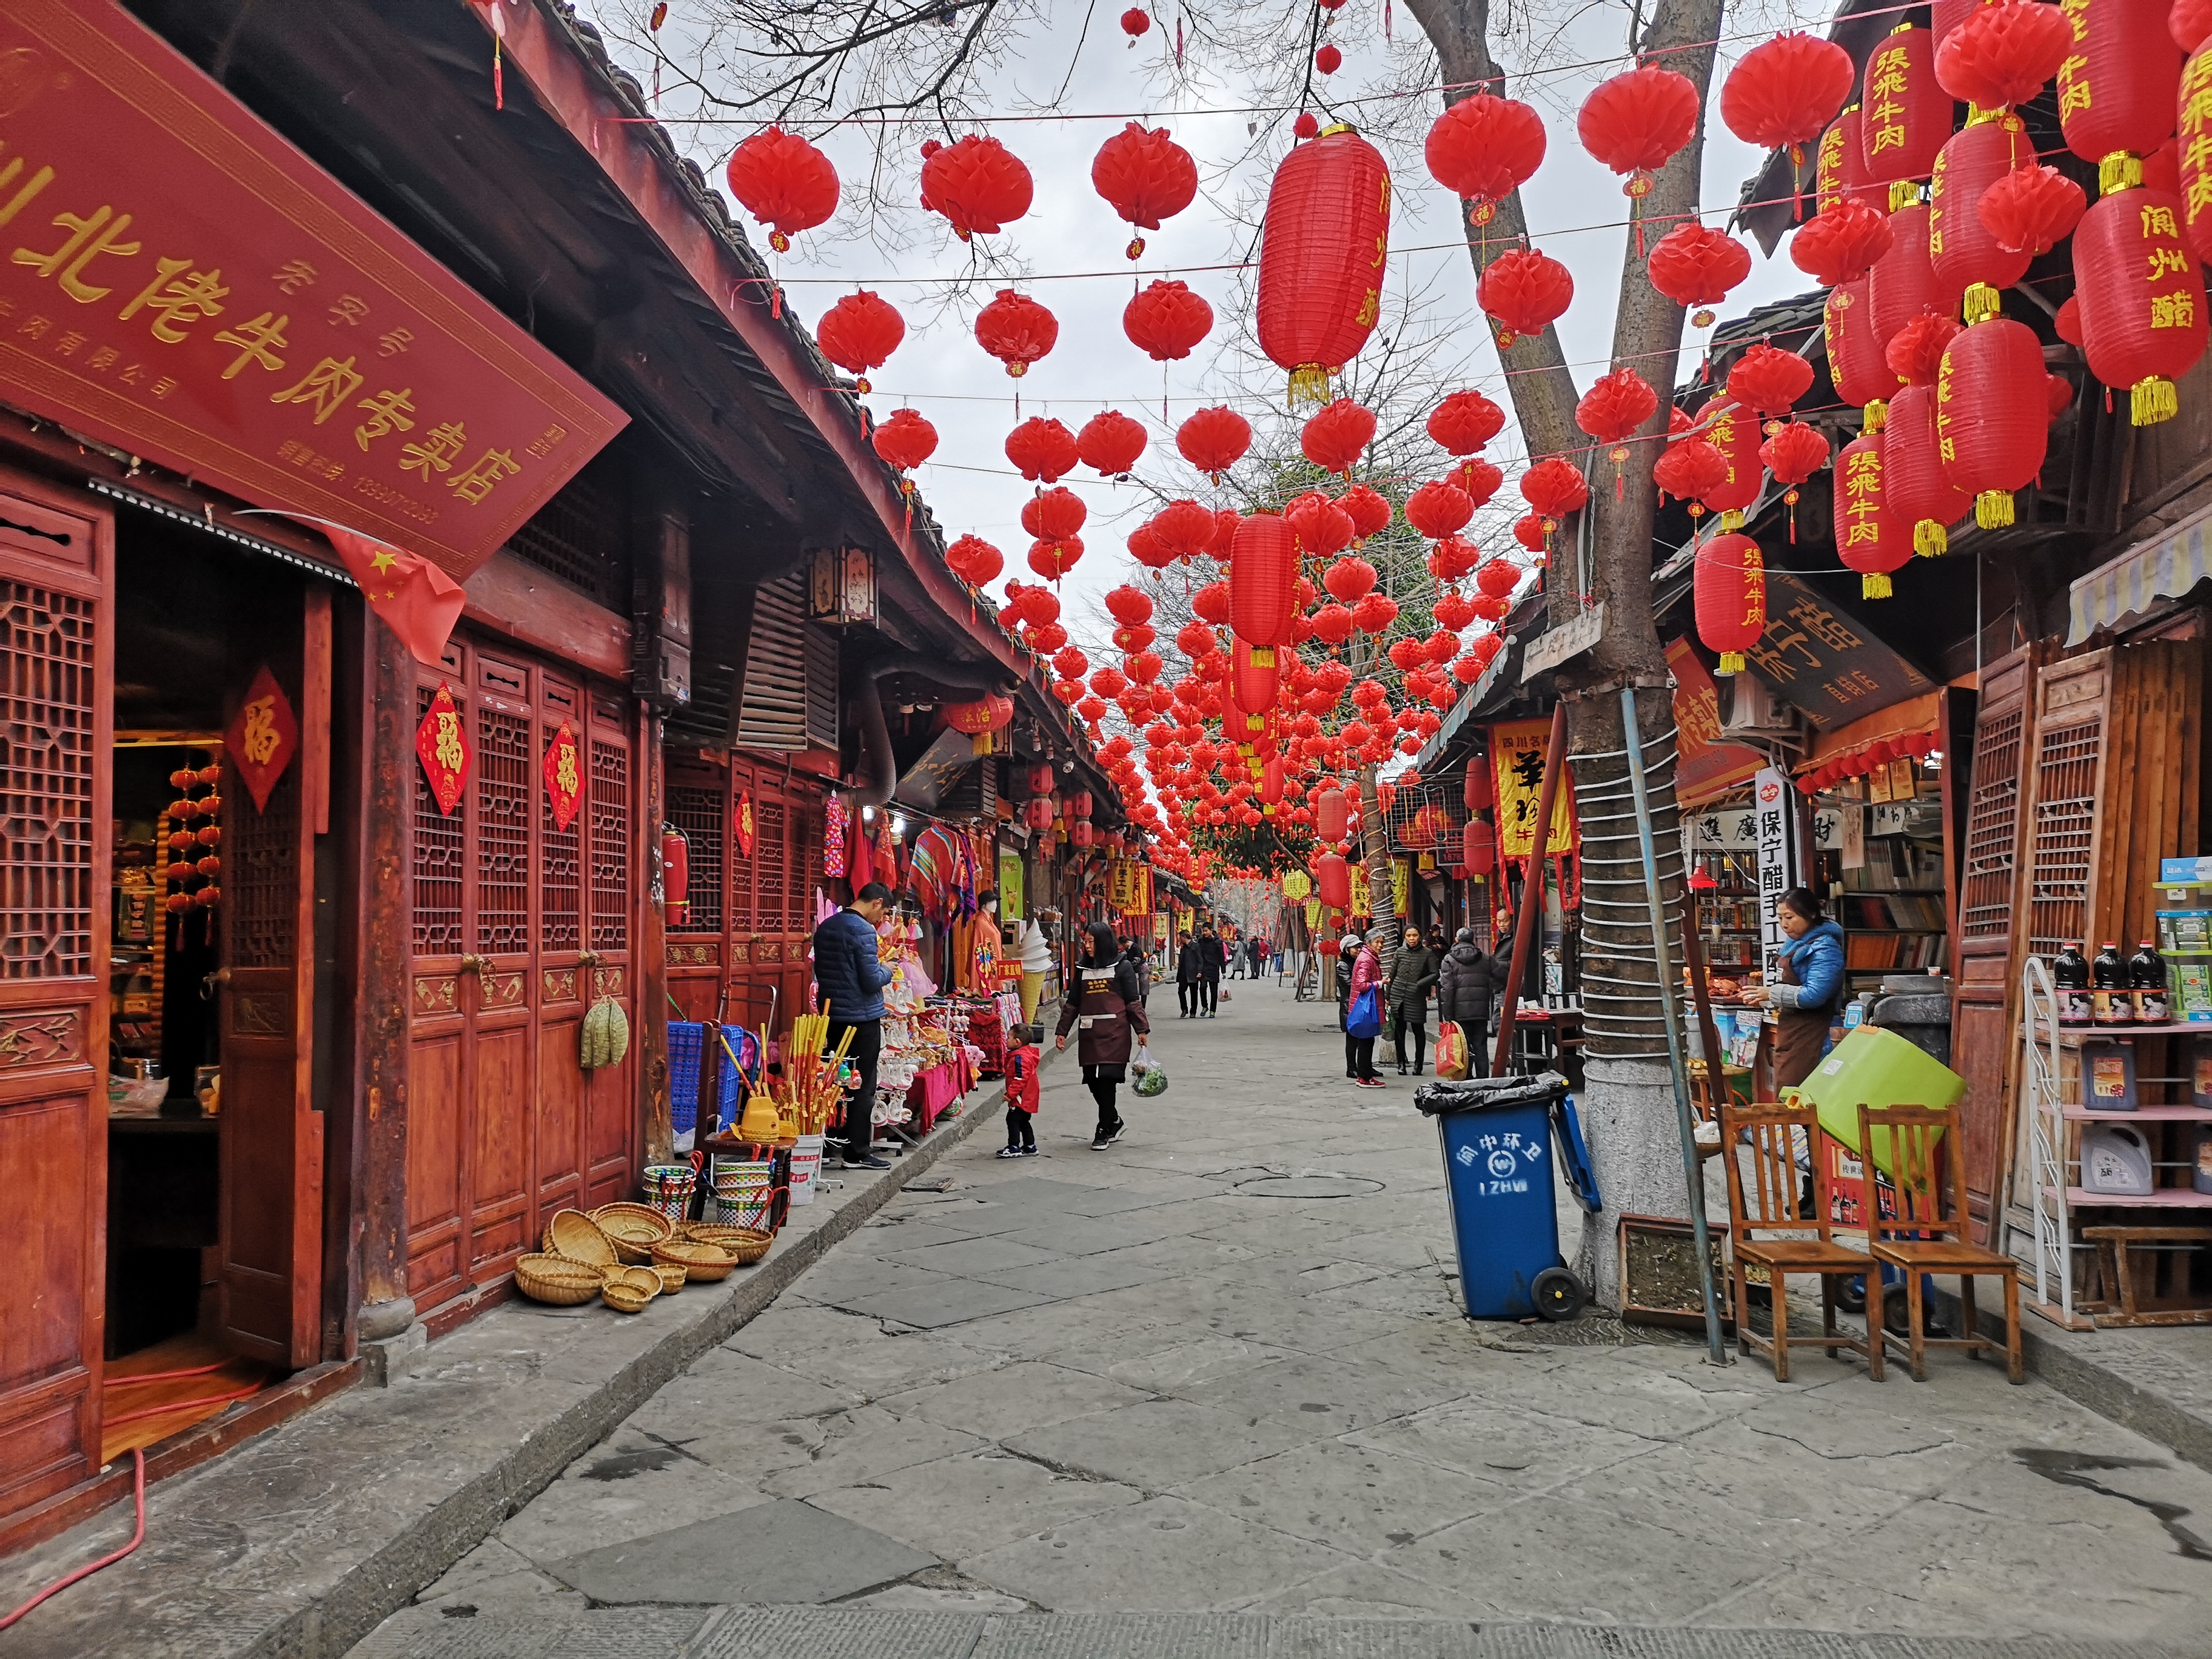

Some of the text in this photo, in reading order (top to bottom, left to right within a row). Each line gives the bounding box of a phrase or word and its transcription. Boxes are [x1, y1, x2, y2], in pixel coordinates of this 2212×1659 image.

[1872, 47, 1911, 155] 張飛牛肉
[1631, 179, 1646, 194] 福
[1476, 205, 1489, 221] 福
[773, 235, 784, 249] 福
[1133, 241, 1141, 255] 福
[272, 259, 415, 357] 老字号
[1011, 363, 1022, 375] 福
[1846, 451, 1883, 547] 張飛牛肉
[1741, 548, 1765, 626] 張飛牛肉
[1822, 669, 1880, 703] 直销店
[961, 706, 991, 723] 法治
[1517, 828, 1557, 841] 牛肉
[998, 964, 1022, 976] 厂家直销
